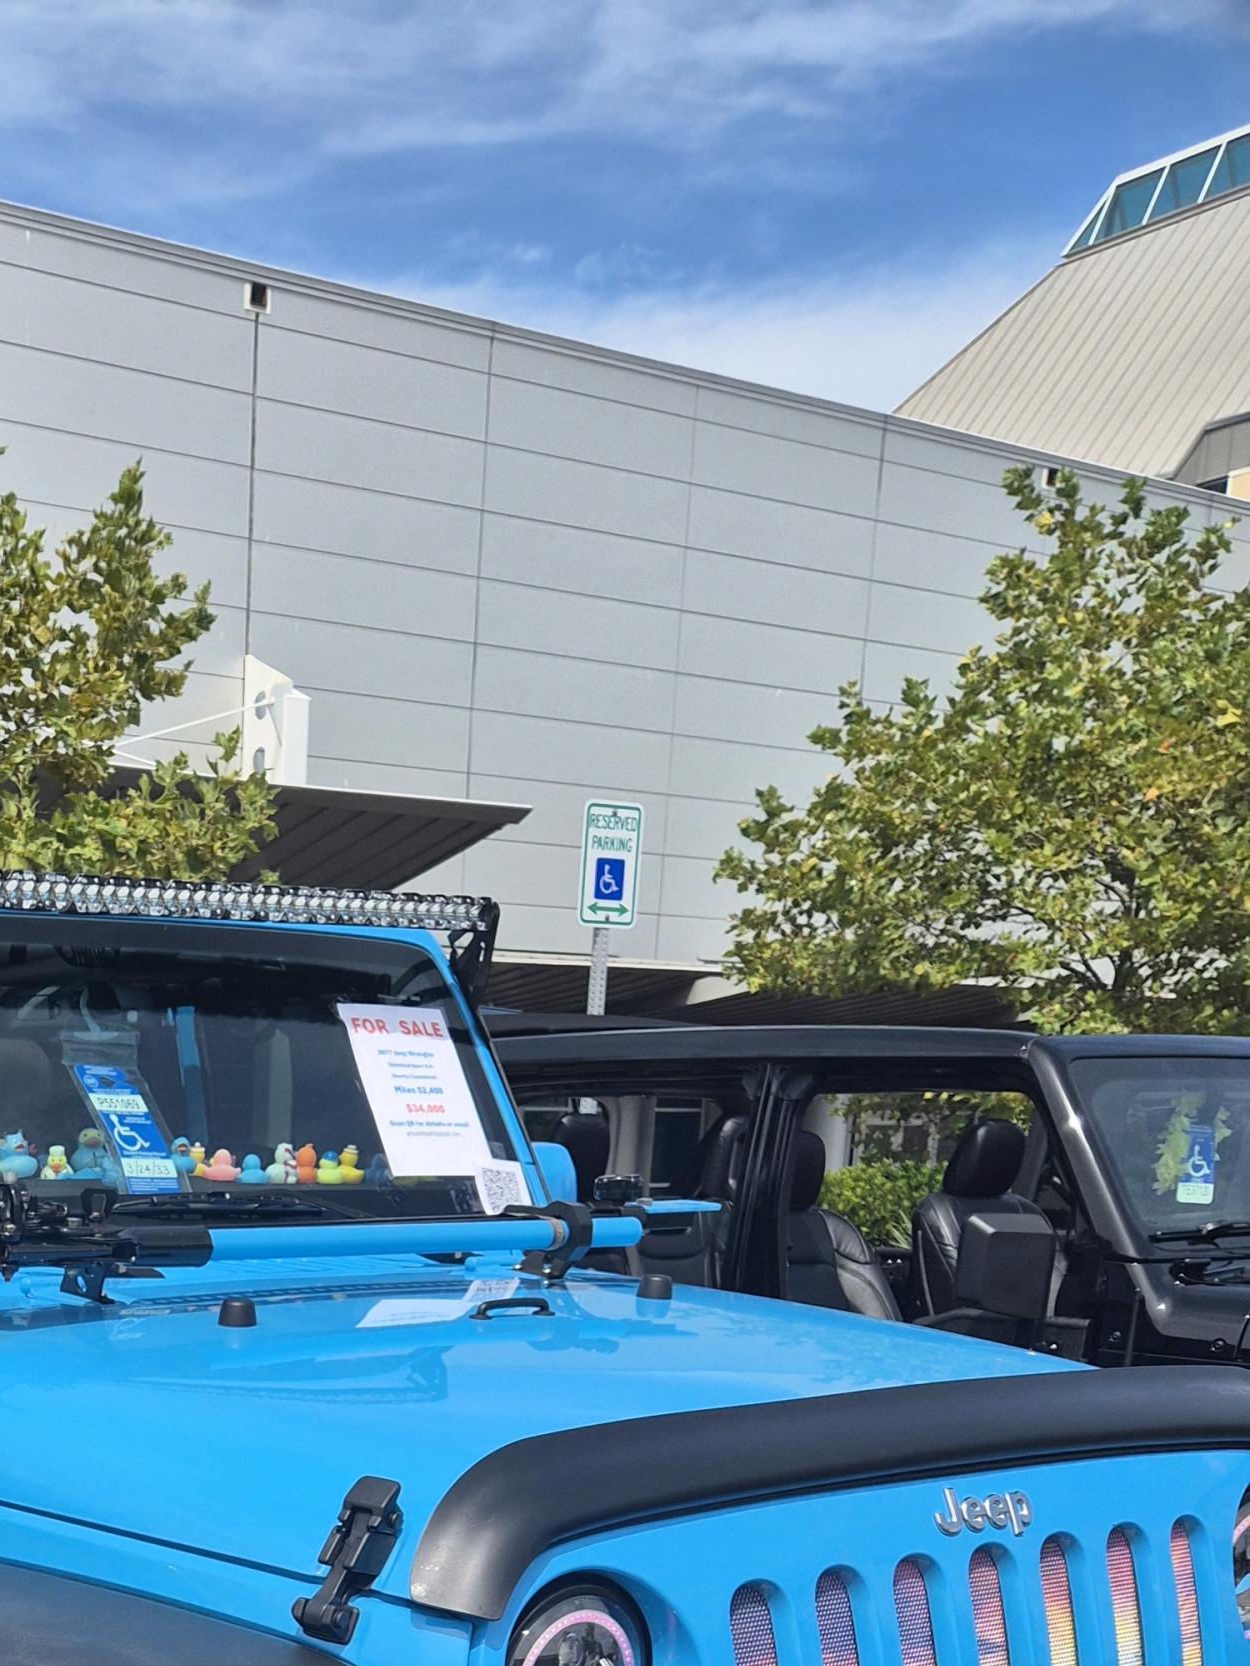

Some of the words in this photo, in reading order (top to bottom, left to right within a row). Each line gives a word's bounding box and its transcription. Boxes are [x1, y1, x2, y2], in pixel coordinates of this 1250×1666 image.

[589, 813, 638, 832] RESERVED
[591, 835, 633, 853] PARKING
[350, 1017, 390, 1035] FOR
[399, 1019, 444, 1038] SALE
[393, 1086, 416, 1095] Miles
[405, 1104, 446, 1114] $34,000
[933, 1487, 1032, 1537] Jeep
